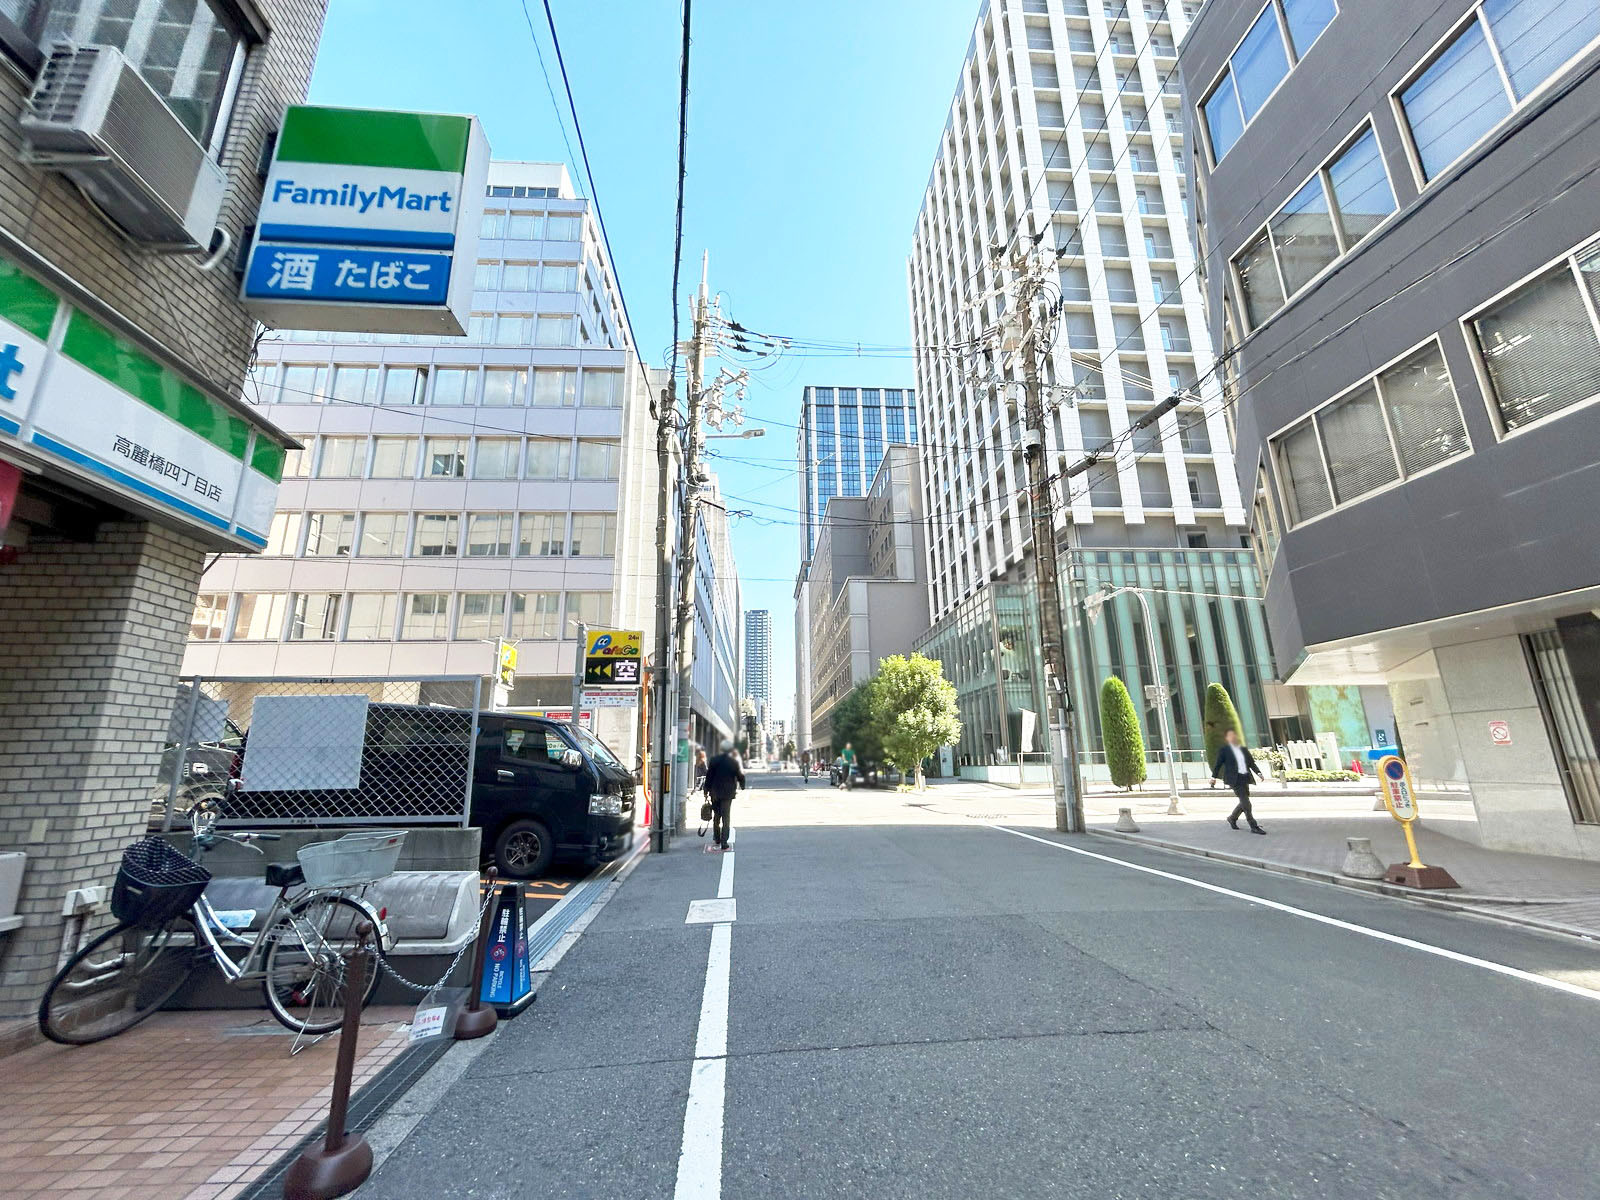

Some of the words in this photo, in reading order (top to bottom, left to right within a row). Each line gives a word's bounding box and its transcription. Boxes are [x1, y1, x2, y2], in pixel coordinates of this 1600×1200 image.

[272, 180, 453, 213] FamilyMart
[266, 251, 320, 291] 酒
[334, 258, 432, 290] たばこ
[112, 434, 223, 502] 高麗橋四丁目店
[614, 660, 638, 682] 空
[489, 972, 499, 998] PARKING
[497, 970, 505, 989] BICYCLE
